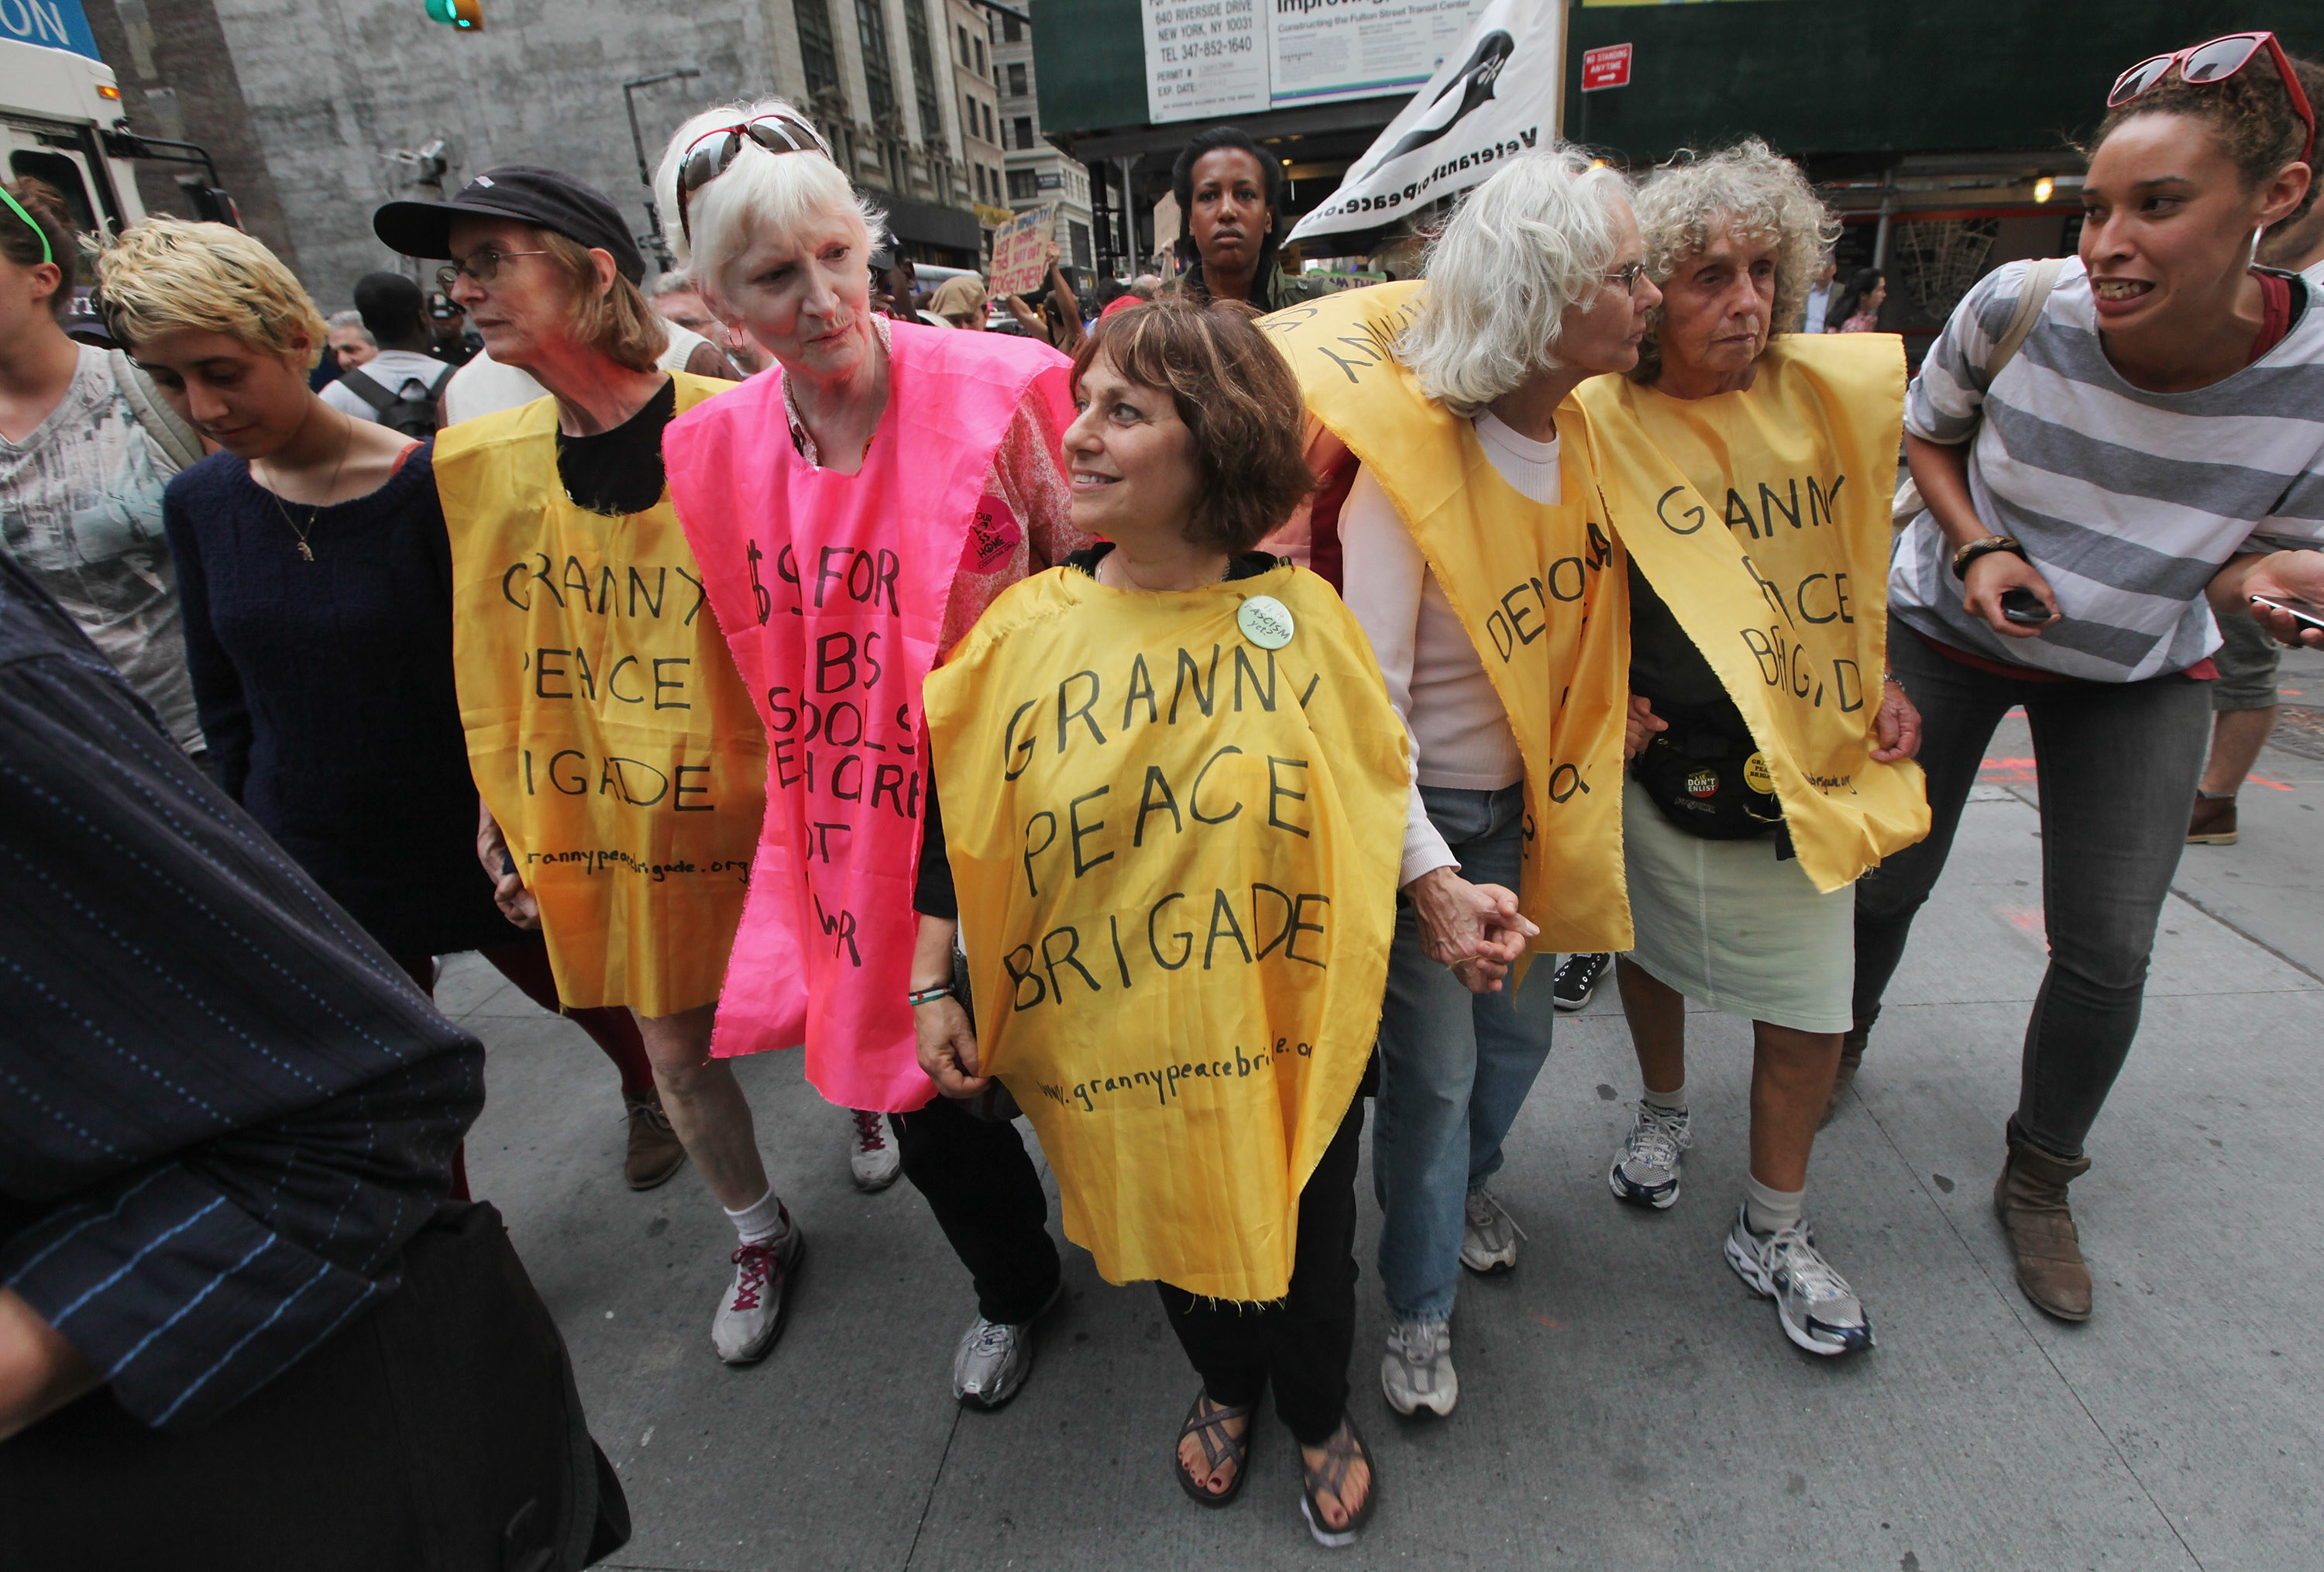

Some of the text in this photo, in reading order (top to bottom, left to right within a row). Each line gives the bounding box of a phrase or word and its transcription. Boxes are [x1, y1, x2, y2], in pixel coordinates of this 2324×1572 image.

[1156, 12, 1172, 25] 640
[1176, 2, 1222, 21] RIVERSIDE
[1226, 0, 1253, 14] DRIVE
[1158, 28, 1177, 41] NEW
[1211, 22, 1222, 33] NY
[1226, 15, 1253, 32] 10031
[1278, 19, 1333, 32] Constructing
[1335, 15, 1349, 24] the
[1350, 12, 1377, 22] Fulton
[1380, 7, 1406, 18] Street
[1408, 3, 1438, 13] Transit
[1439, 0, 1470, 10] Center
[1160, 36, 1253, 63] TEL 347-852-1640
[1586, 49, 1628, 64] NO STANDING
[1157, 68, 1183, 81] PERMIT
[814, 545, 899, 617] FOR
[1243, 602, 1291, 639] FASCISM
[524, 647, 691, 710] EACE
[524, 749, 714, 811] IGADE
[1687, 778, 1716, 786] DON'T
[1023, 745, 1309, 897] PEACE
[1003, 882, 1331, 1012] BRIGADE
